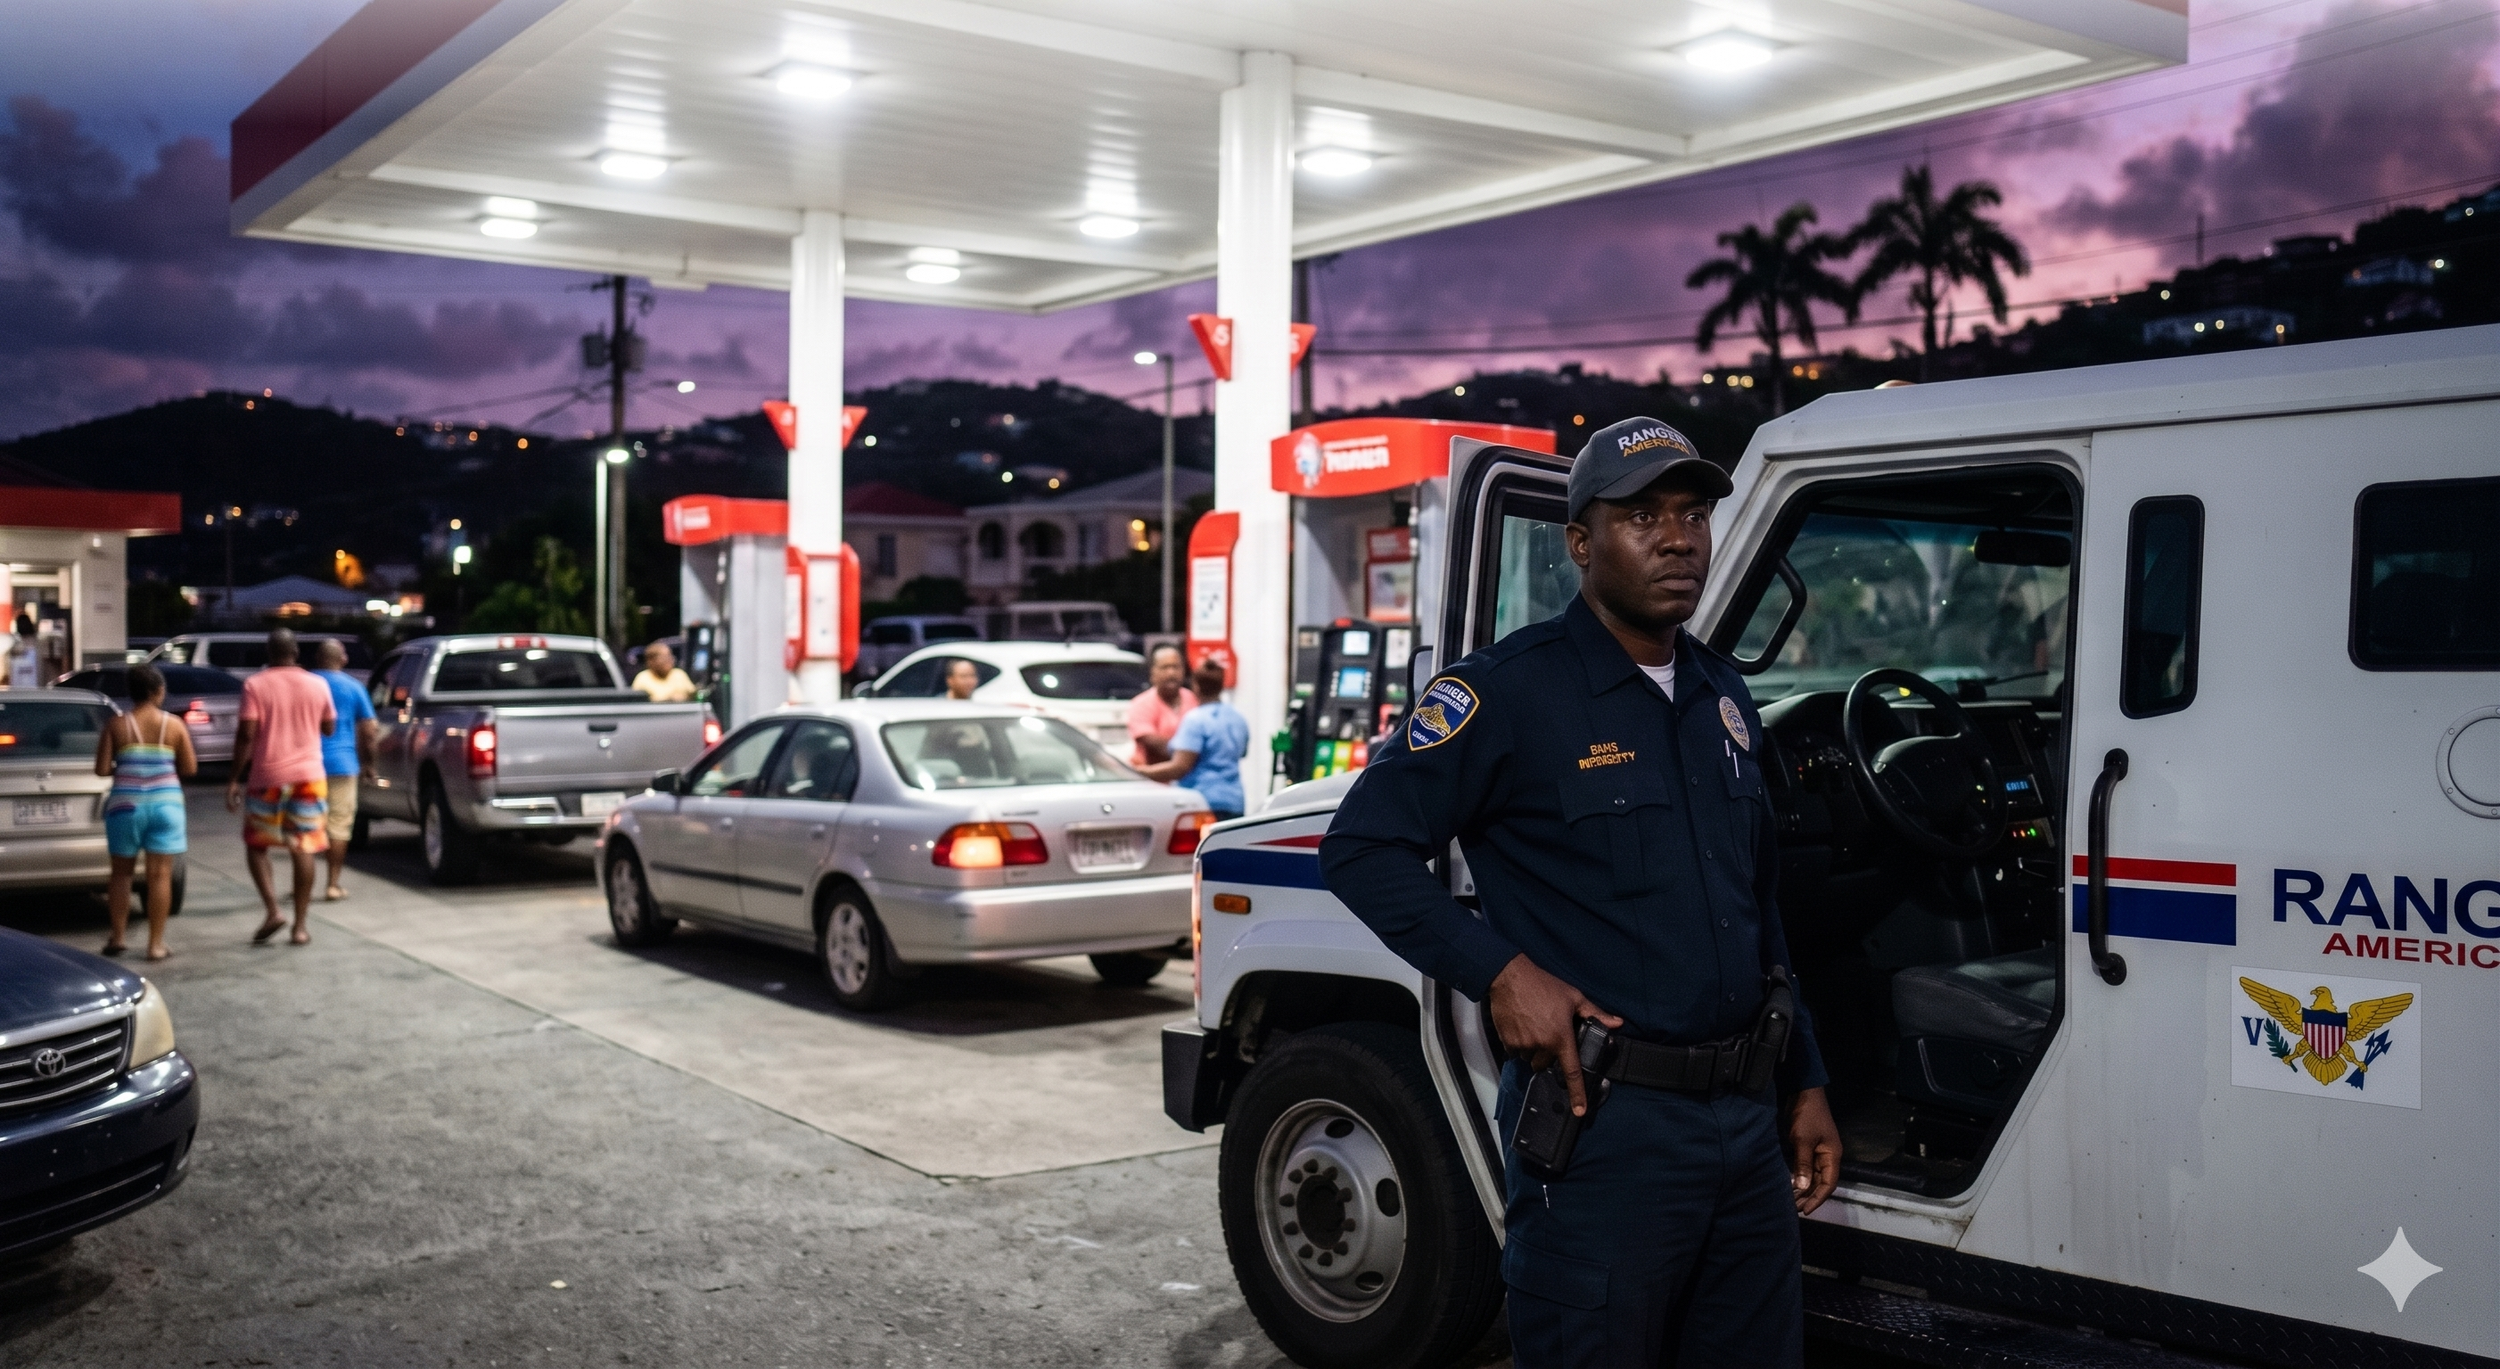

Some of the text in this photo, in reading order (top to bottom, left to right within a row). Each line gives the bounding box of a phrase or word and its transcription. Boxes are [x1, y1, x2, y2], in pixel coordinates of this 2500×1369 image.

[1623, 438, 1690, 457] AMERICAN
[1590, 742, 1618, 755] BAMS
[2273, 868, 2500, 939] RANG
[2322, 933, 2500, 969] AMERIC
[2241, 1016, 2264, 1046] V
